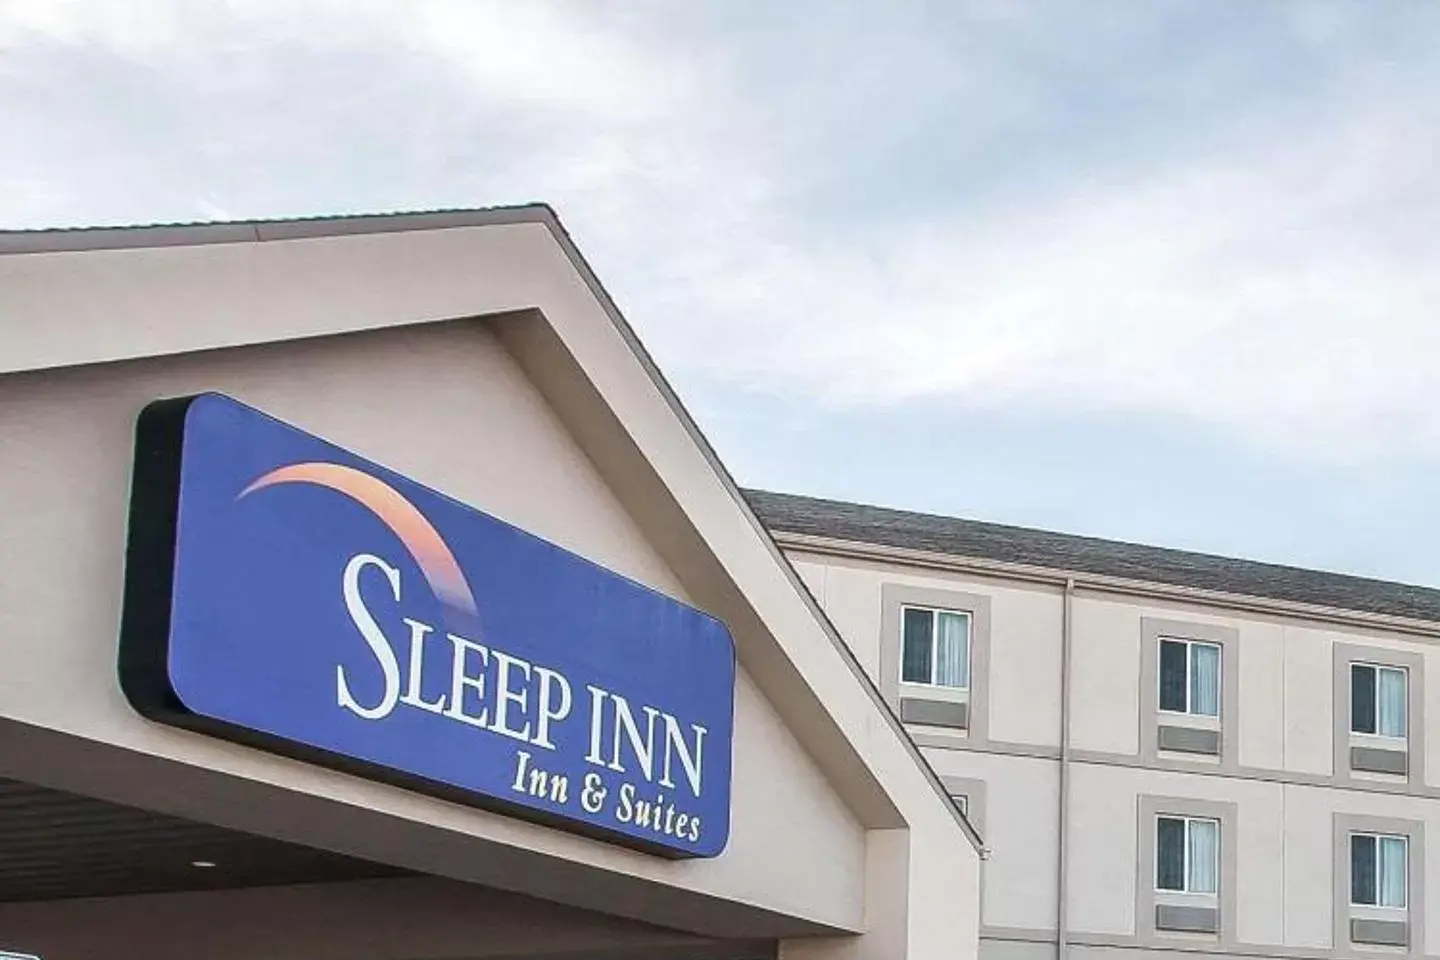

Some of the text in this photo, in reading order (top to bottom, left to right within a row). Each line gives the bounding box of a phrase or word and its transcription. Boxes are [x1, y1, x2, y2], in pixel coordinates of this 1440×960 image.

[337, 553, 708, 798] SLEEP INN
[512, 750, 701, 843] Inn & Suites
